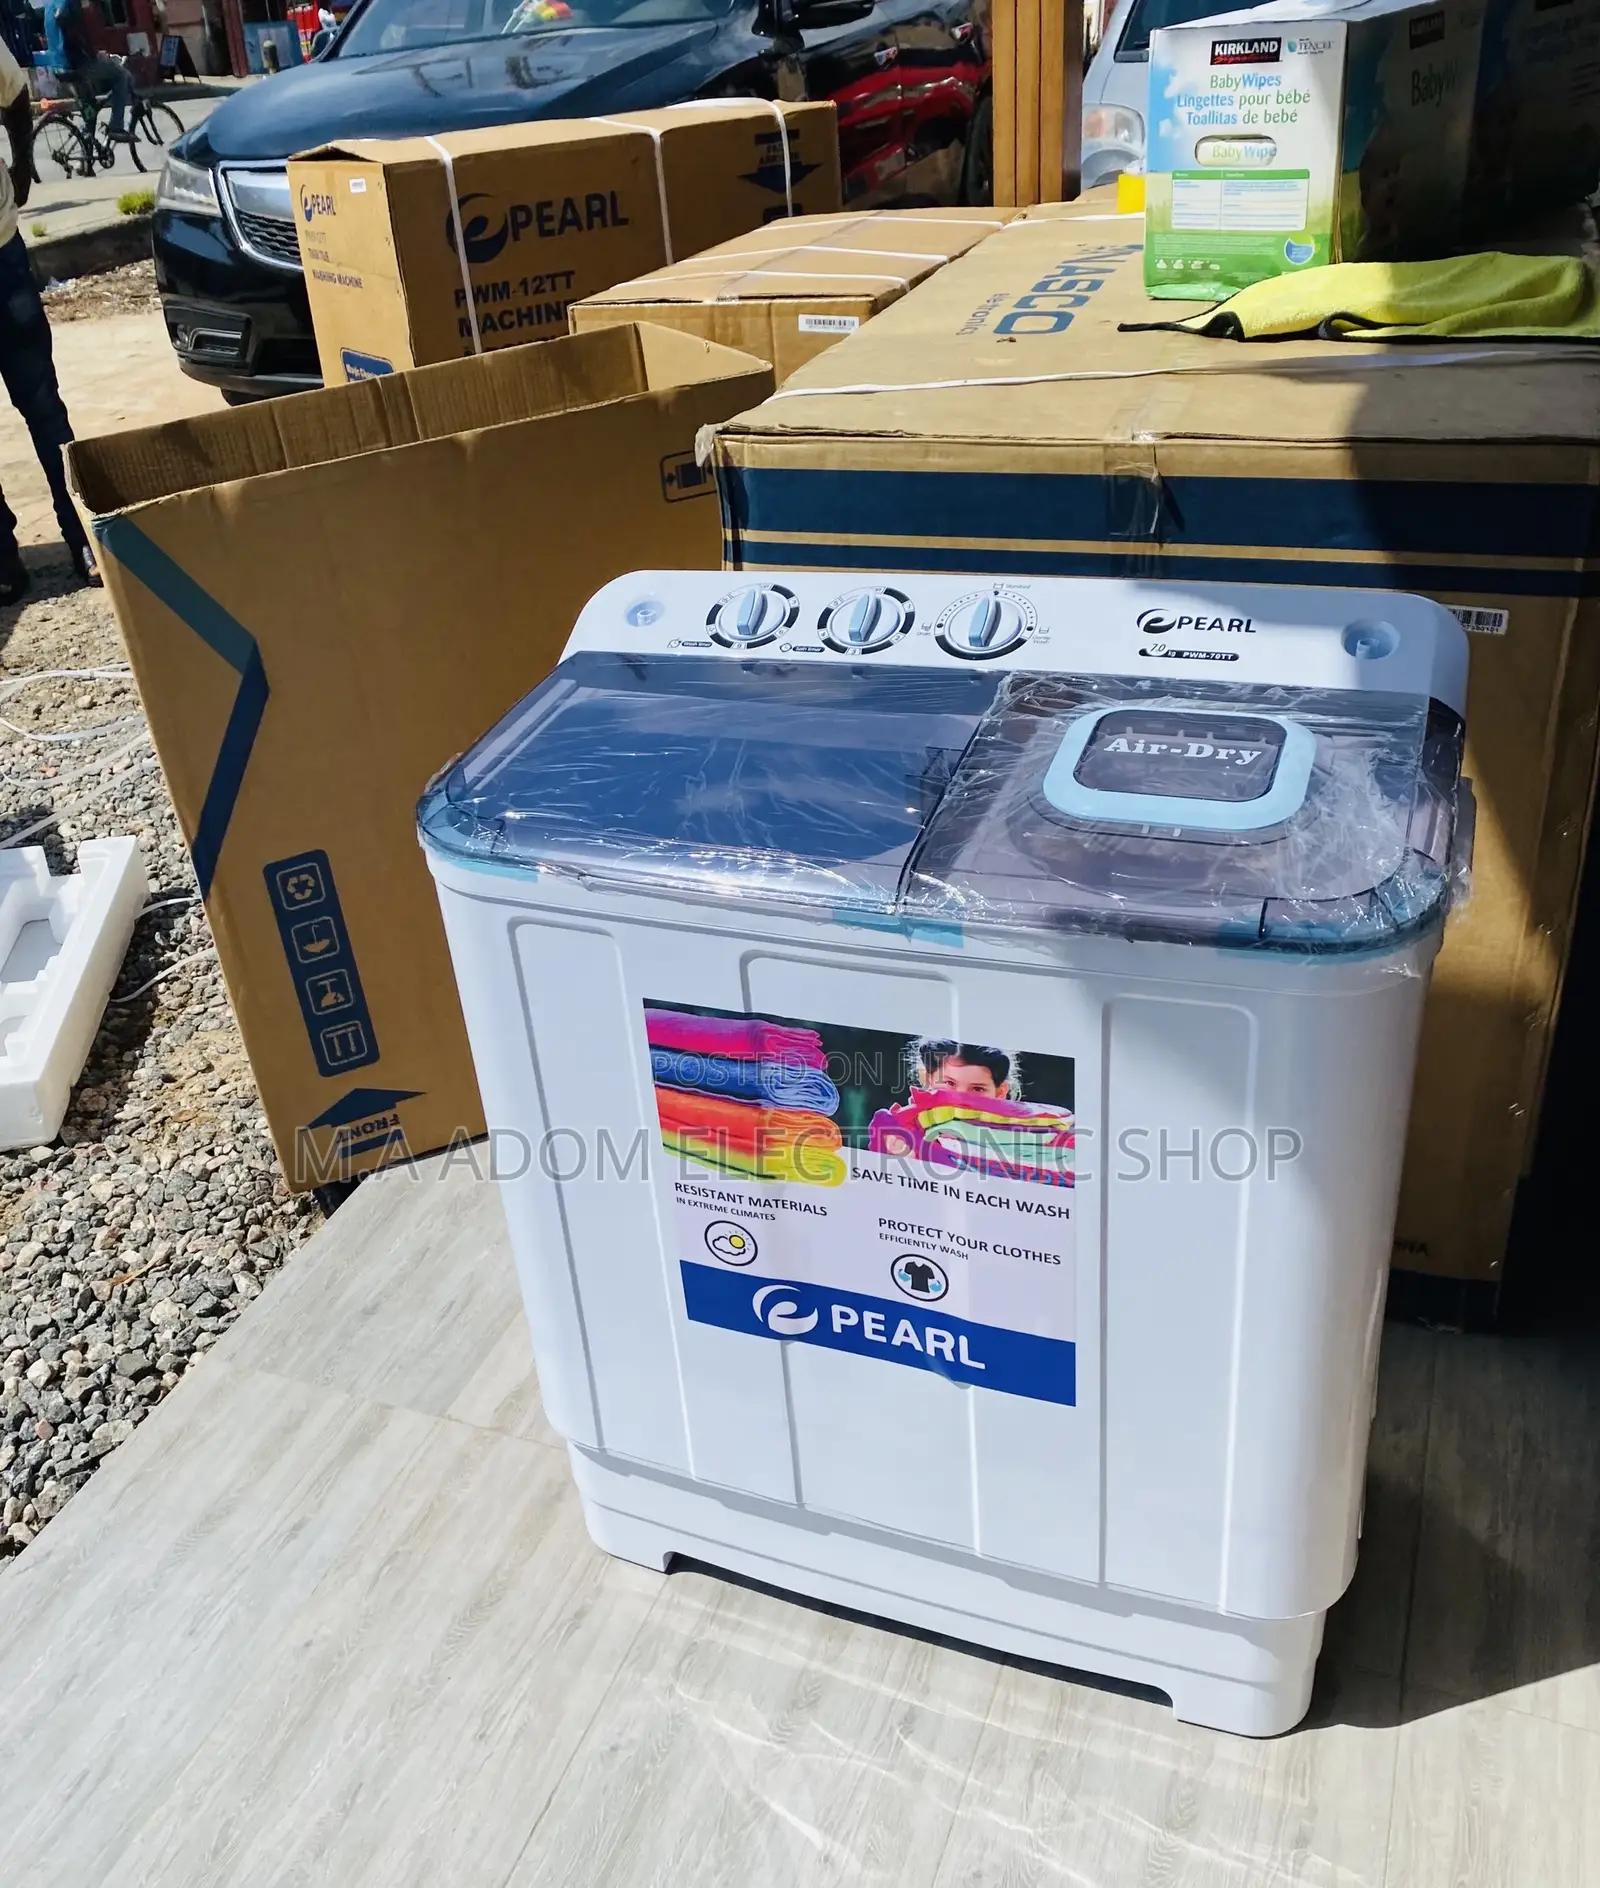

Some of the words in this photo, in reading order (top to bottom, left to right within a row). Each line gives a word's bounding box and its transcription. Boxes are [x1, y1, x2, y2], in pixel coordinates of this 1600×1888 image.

[1214, 41, 1278, 56] KIRKLAND
[1210, 72, 1281, 91] BabyWipes
[1177, 92, 1234, 110] Lingettes
[1239, 93, 1271, 109] pour
[1276, 89, 1311, 105] bébé
[1187, 111, 1237, 125] Toallitas
[1242, 111, 1259, 124] de
[1263, 109, 1298, 123] bebé
[311, 194, 337, 216] PEARL
[509, 190, 630, 242] PEARL
[454, 269, 576, 308] PWM-12TT
[993, 244, 1144, 335] NASCO
[1177, 616, 1257, 633] PEARL
[1168, 650, 1177, 658] kg
[1183, 651, 1234, 660] PWM-70TT
[1104, 738, 1262, 766] Air-Dry
[336, 1113, 400, 1144] FRONT
[674, 1182, 744, 1204] RESISTANT
[749, 1196, 828, 1216] MATERIALS
[852, 1167, 893, 1185] SAVE
[897, 1174, 939, 1193] TIME
[944, 1184, 960, 1199] IN
[965, 1191, 1010, 1210] EACH
[1015, 1199, 1070, 1219] WASH
[676, 1196, 686, 1204] IN
[688, 1200, 728, 1213] EXTREME
[730, 1207, 776, 1221] CLIMATES
[878, 1218, 943, 1239] PROTECT
[947, 1233, 989, 1252] YOUR
[992, 1244, 1061, 1265] CLOTHES
[879, 1232, 937, 1251] EFFICIENTLY
[939, 1244, 969, 1260] WASH
[830, 1303, 986, 1370] PEARL
